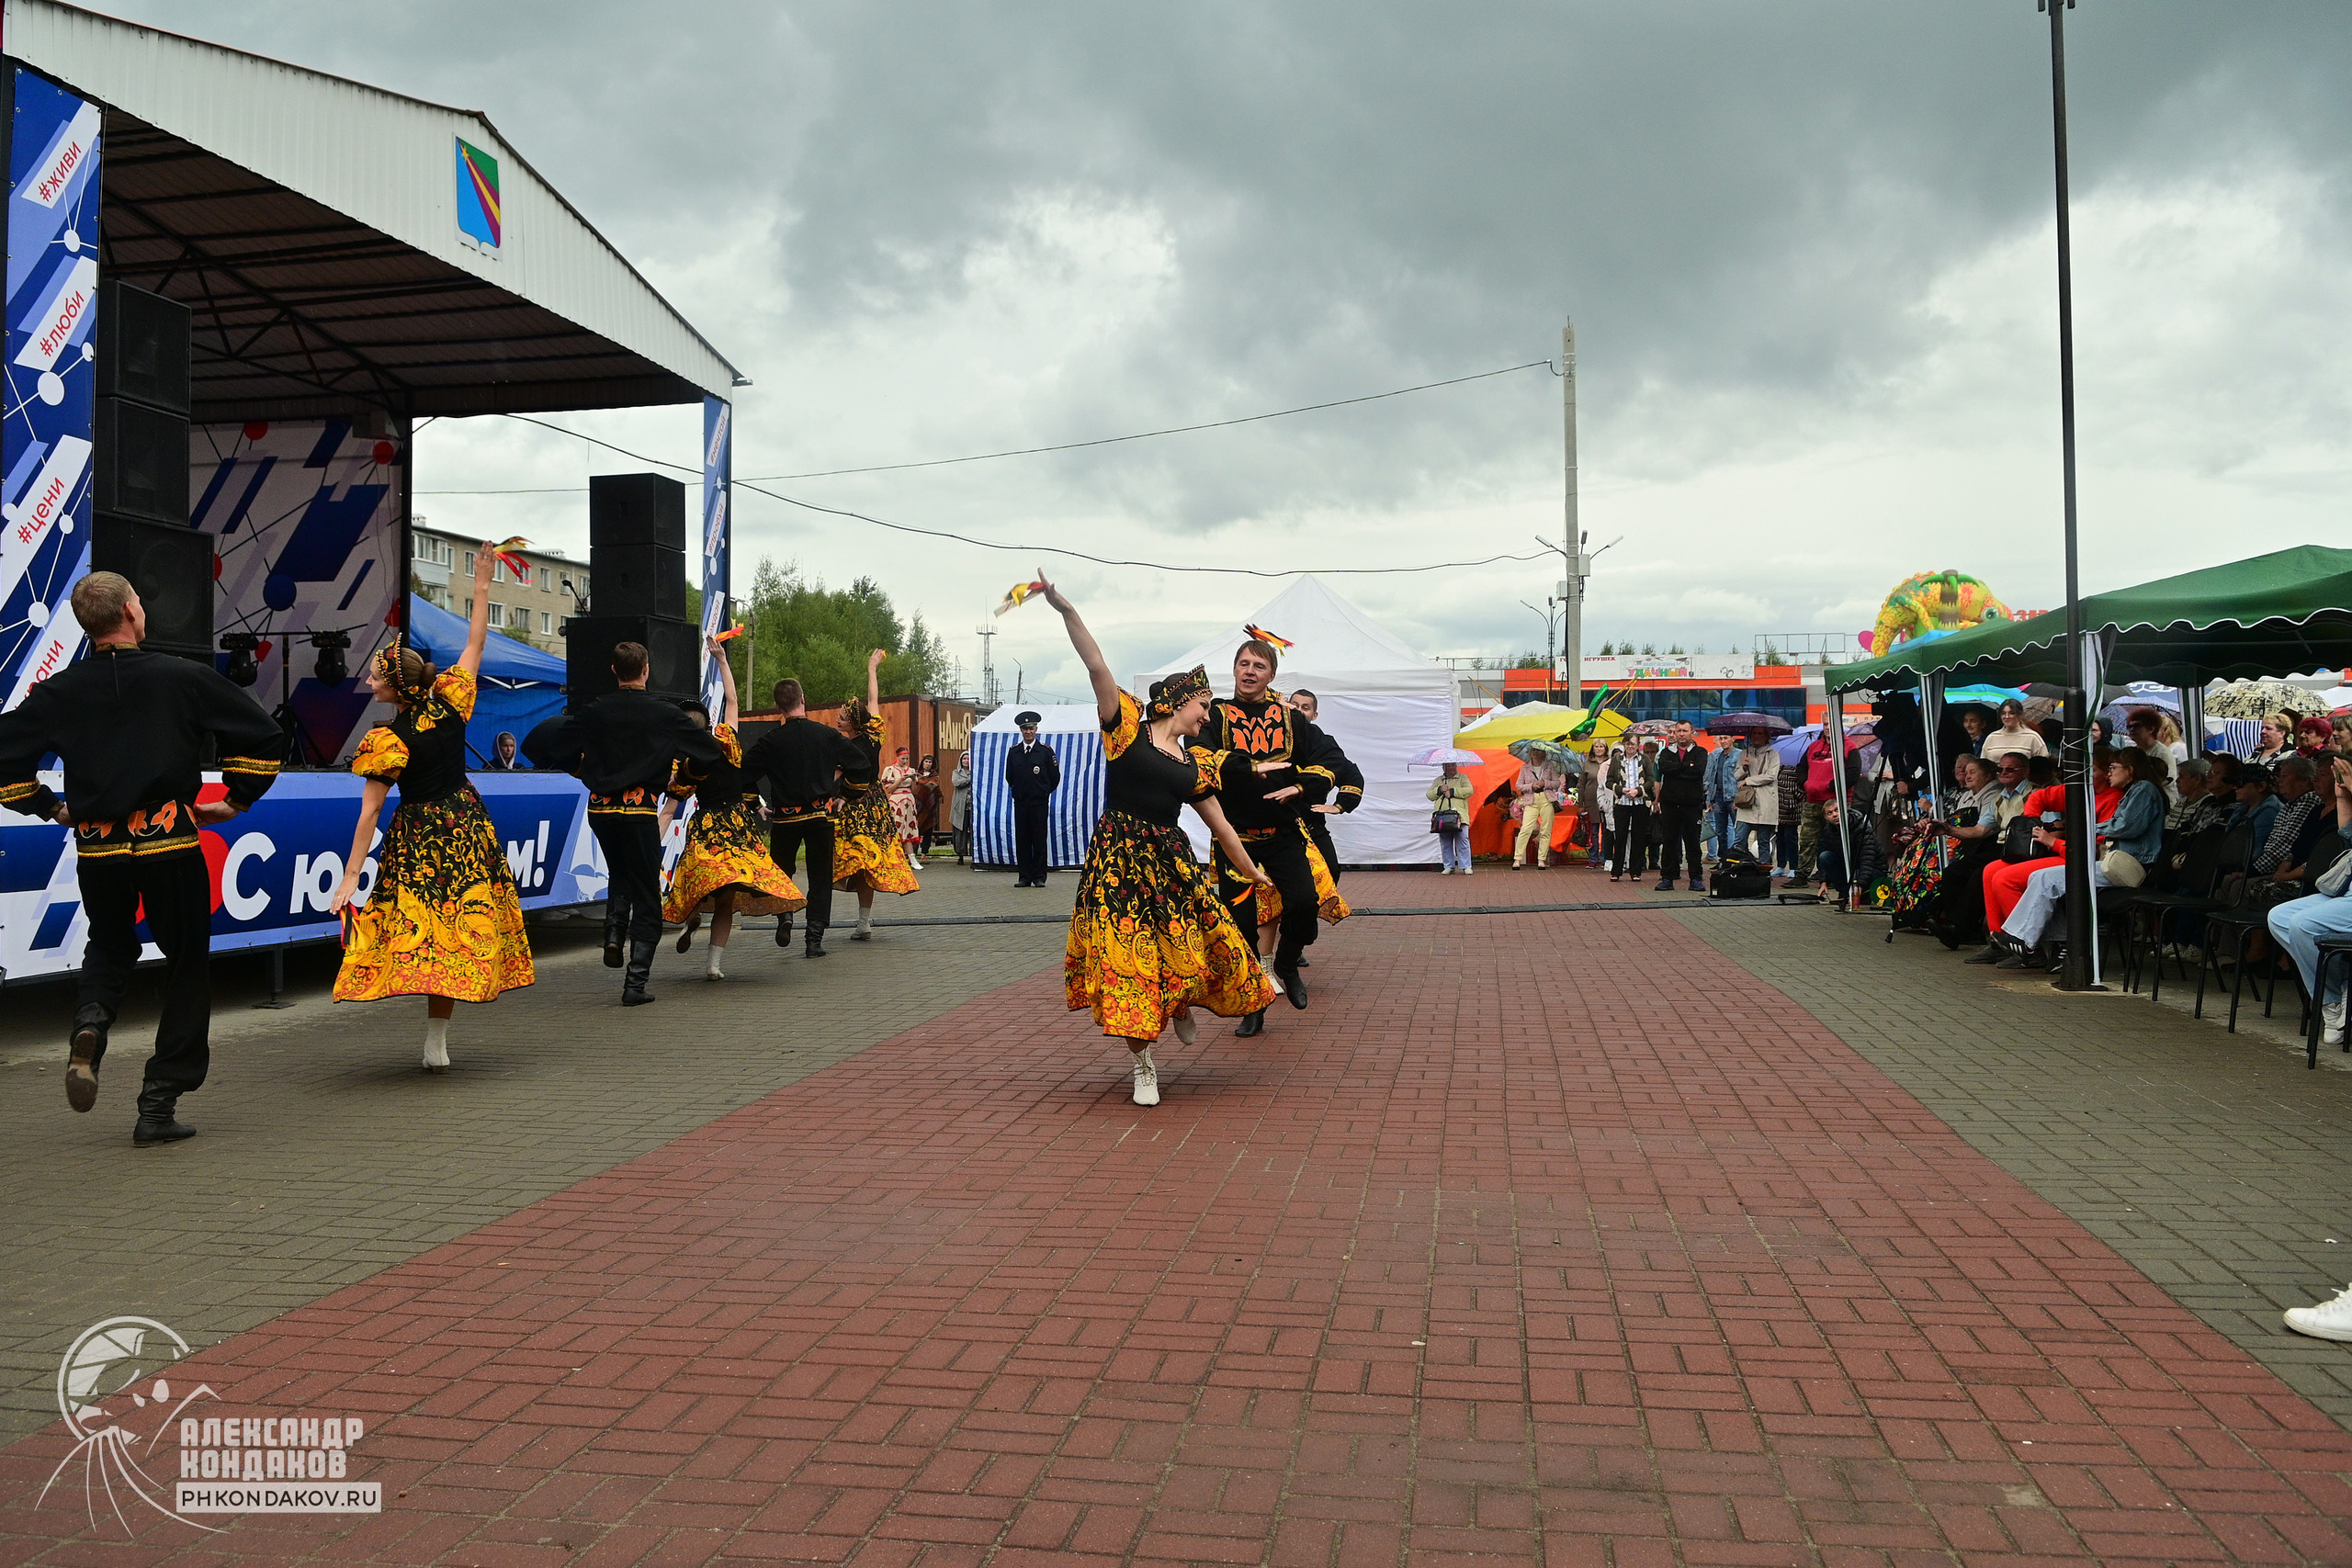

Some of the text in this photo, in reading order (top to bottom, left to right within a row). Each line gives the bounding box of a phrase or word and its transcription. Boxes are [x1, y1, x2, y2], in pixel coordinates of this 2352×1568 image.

[40, 290, 85, 357] #люби
[710, 415, 726, 464] #мечтай
[17, 477, 65, 544] #цени
[1628, 667, 1688, 678] УДАЧНЫЙ
[221, 831, 276, 920] С
